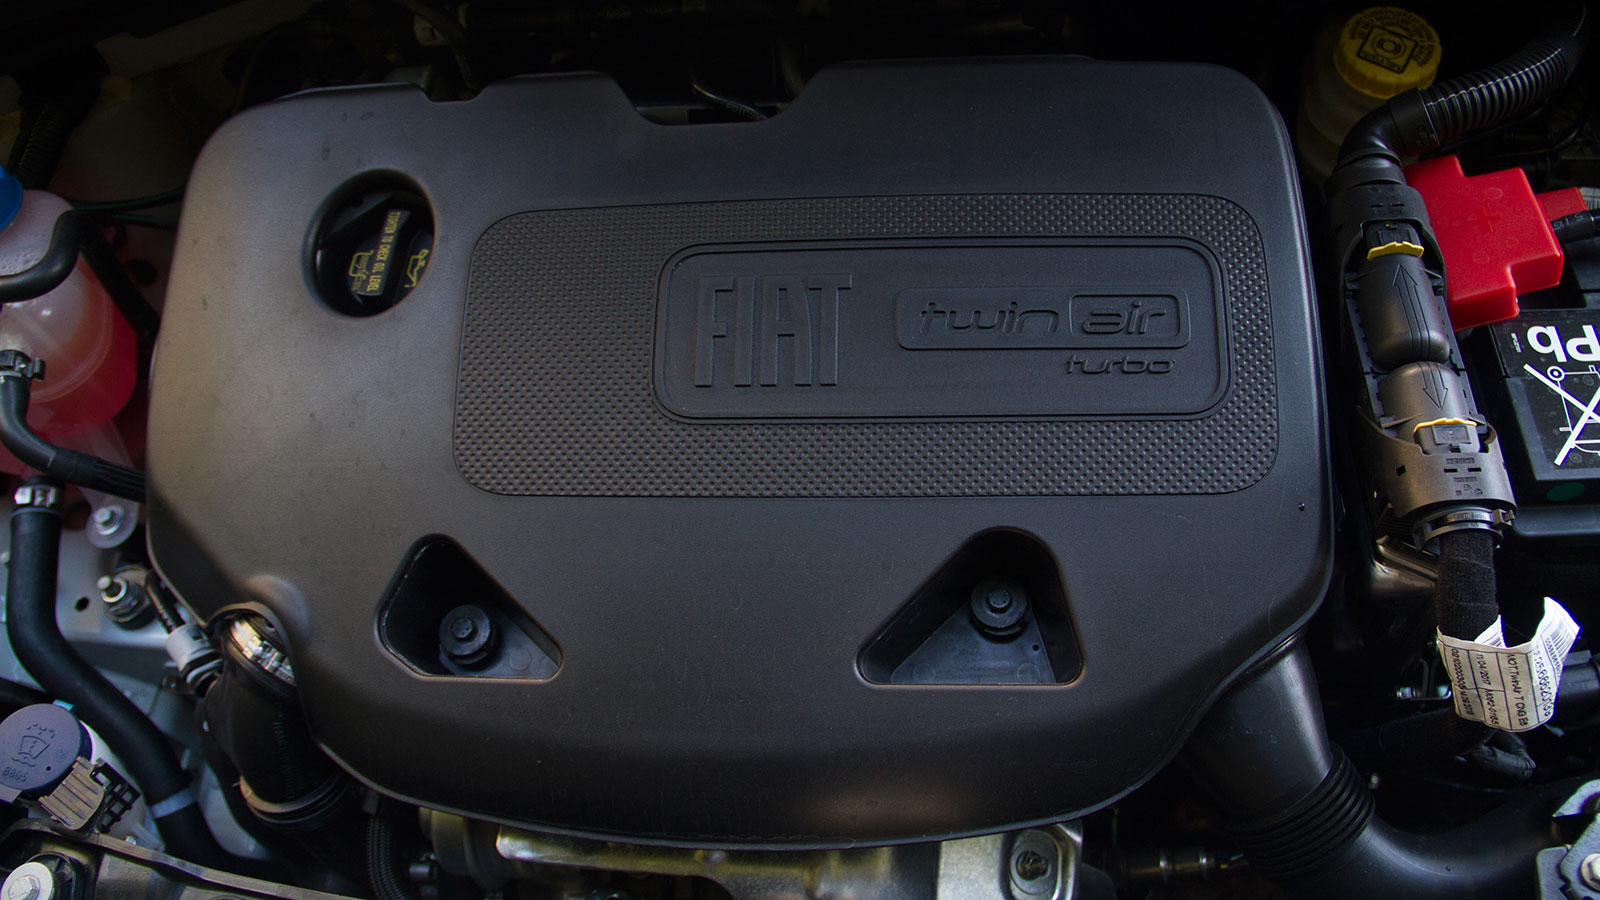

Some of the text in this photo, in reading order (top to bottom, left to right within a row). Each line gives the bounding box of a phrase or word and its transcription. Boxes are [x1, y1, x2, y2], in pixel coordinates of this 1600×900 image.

[381, 235, 394, 243] TO
[376, 244, 391, 261] CHECK
[371, 262, 385, 273] OIL
[366, 275, 381, 292] LEVEL
[920, 300, 1167, 336] twin air
[695, 273, 852, 387] FIAT
[1526, 324, 1600, 363] Pb
[1066, 354, 1175, 375] turbo
